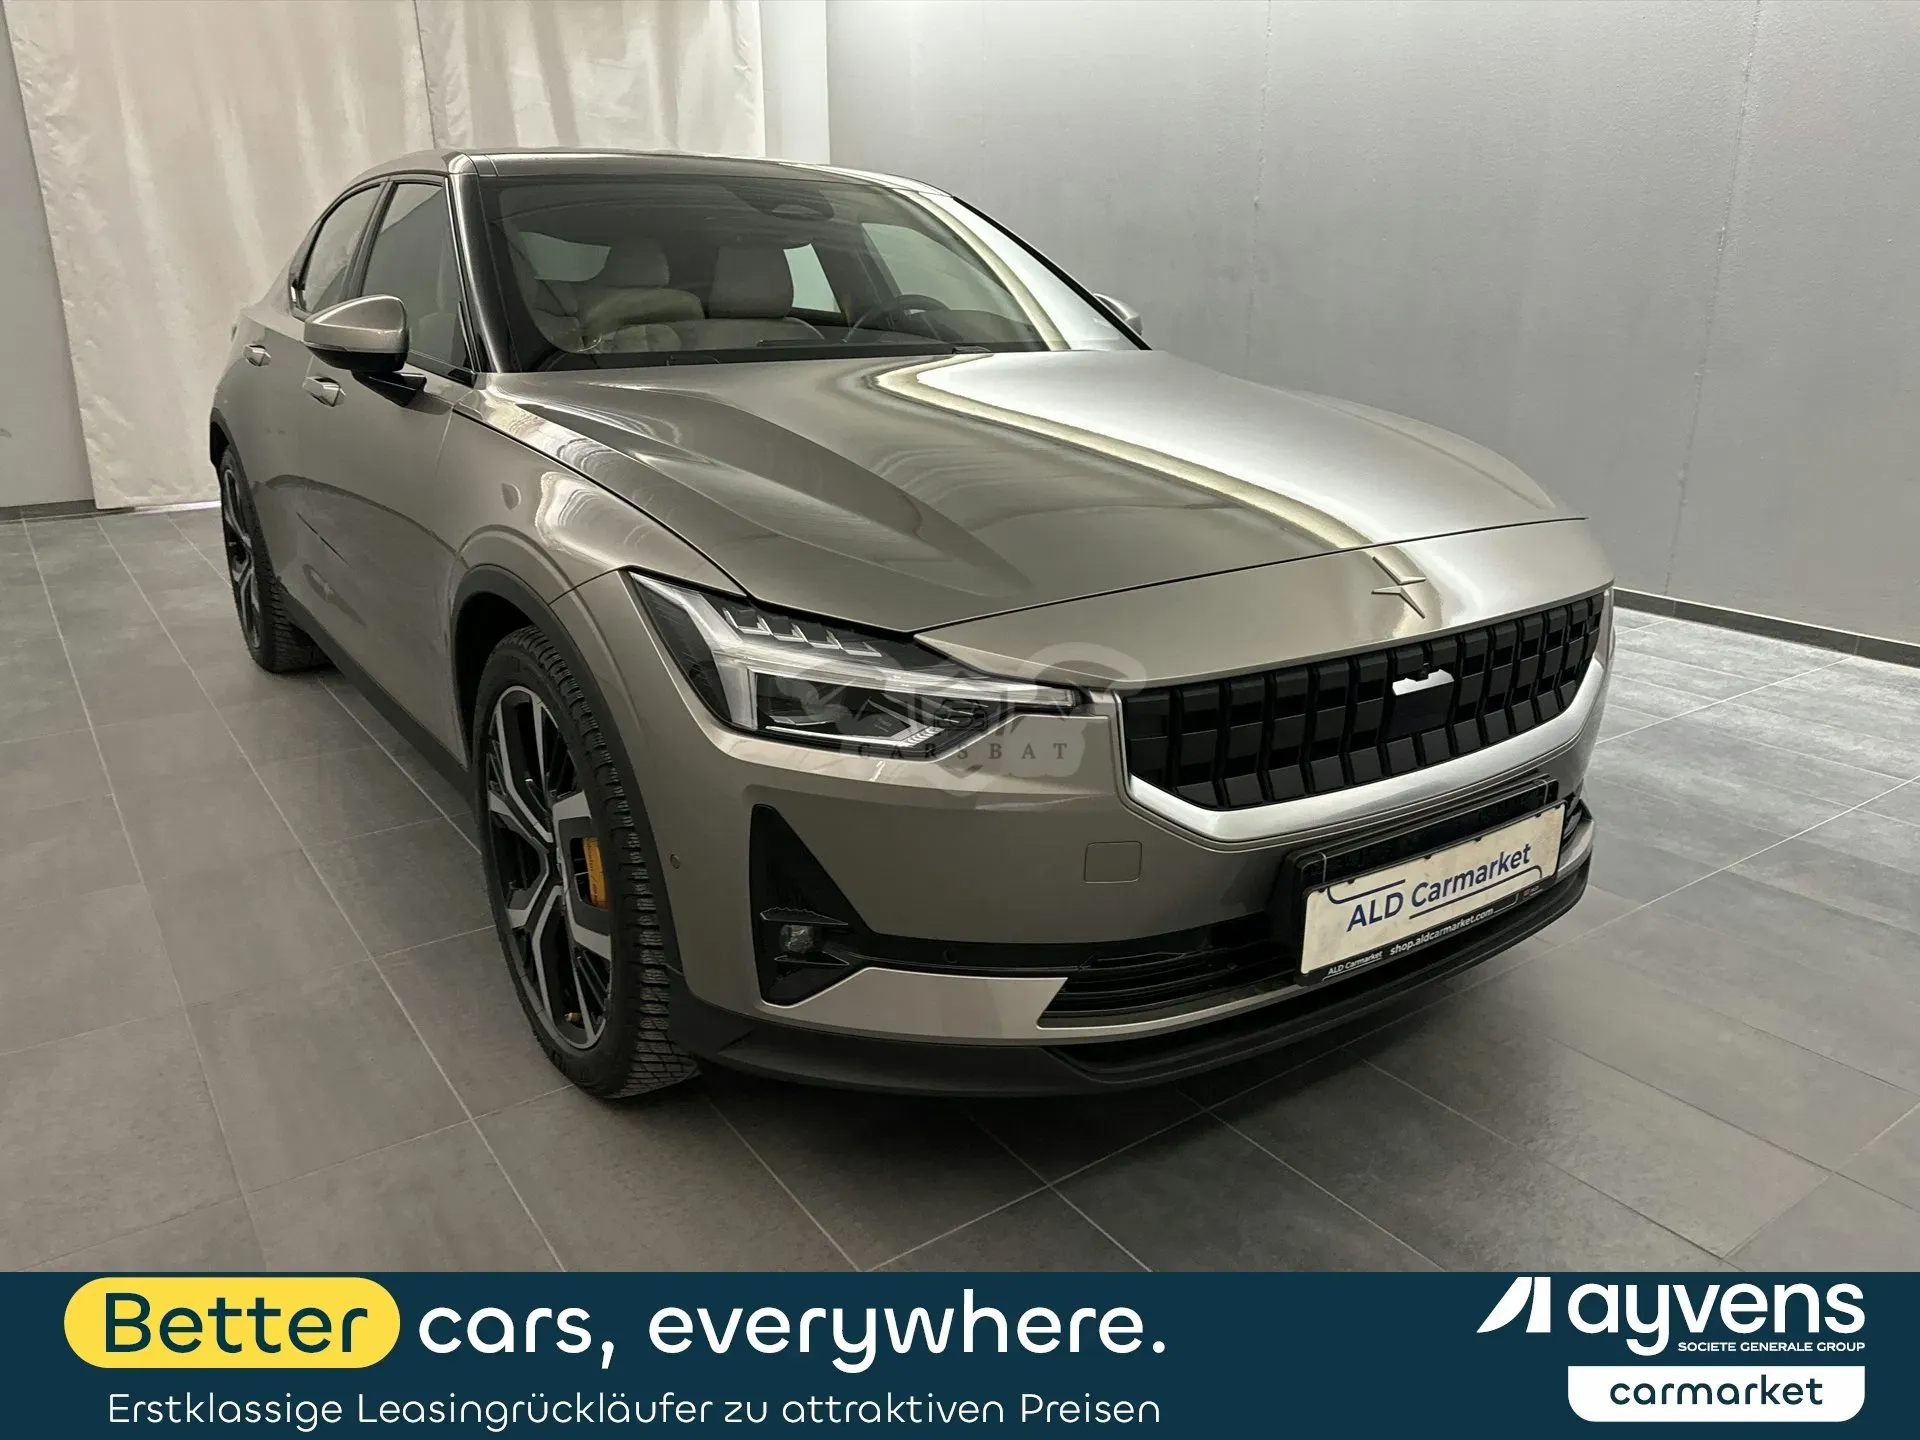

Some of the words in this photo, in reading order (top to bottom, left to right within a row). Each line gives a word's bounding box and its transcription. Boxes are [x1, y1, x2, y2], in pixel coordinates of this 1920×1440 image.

[1347, 892, 1404, 932] ALD
[1411, 843, 1532, 908] Carmarket
[1389, 907, 1494, 956] shop.aldcarmarket.com
[1327, 964, 1345, 976] ALD
[1345, 950, 1383, 969] Carmarket
